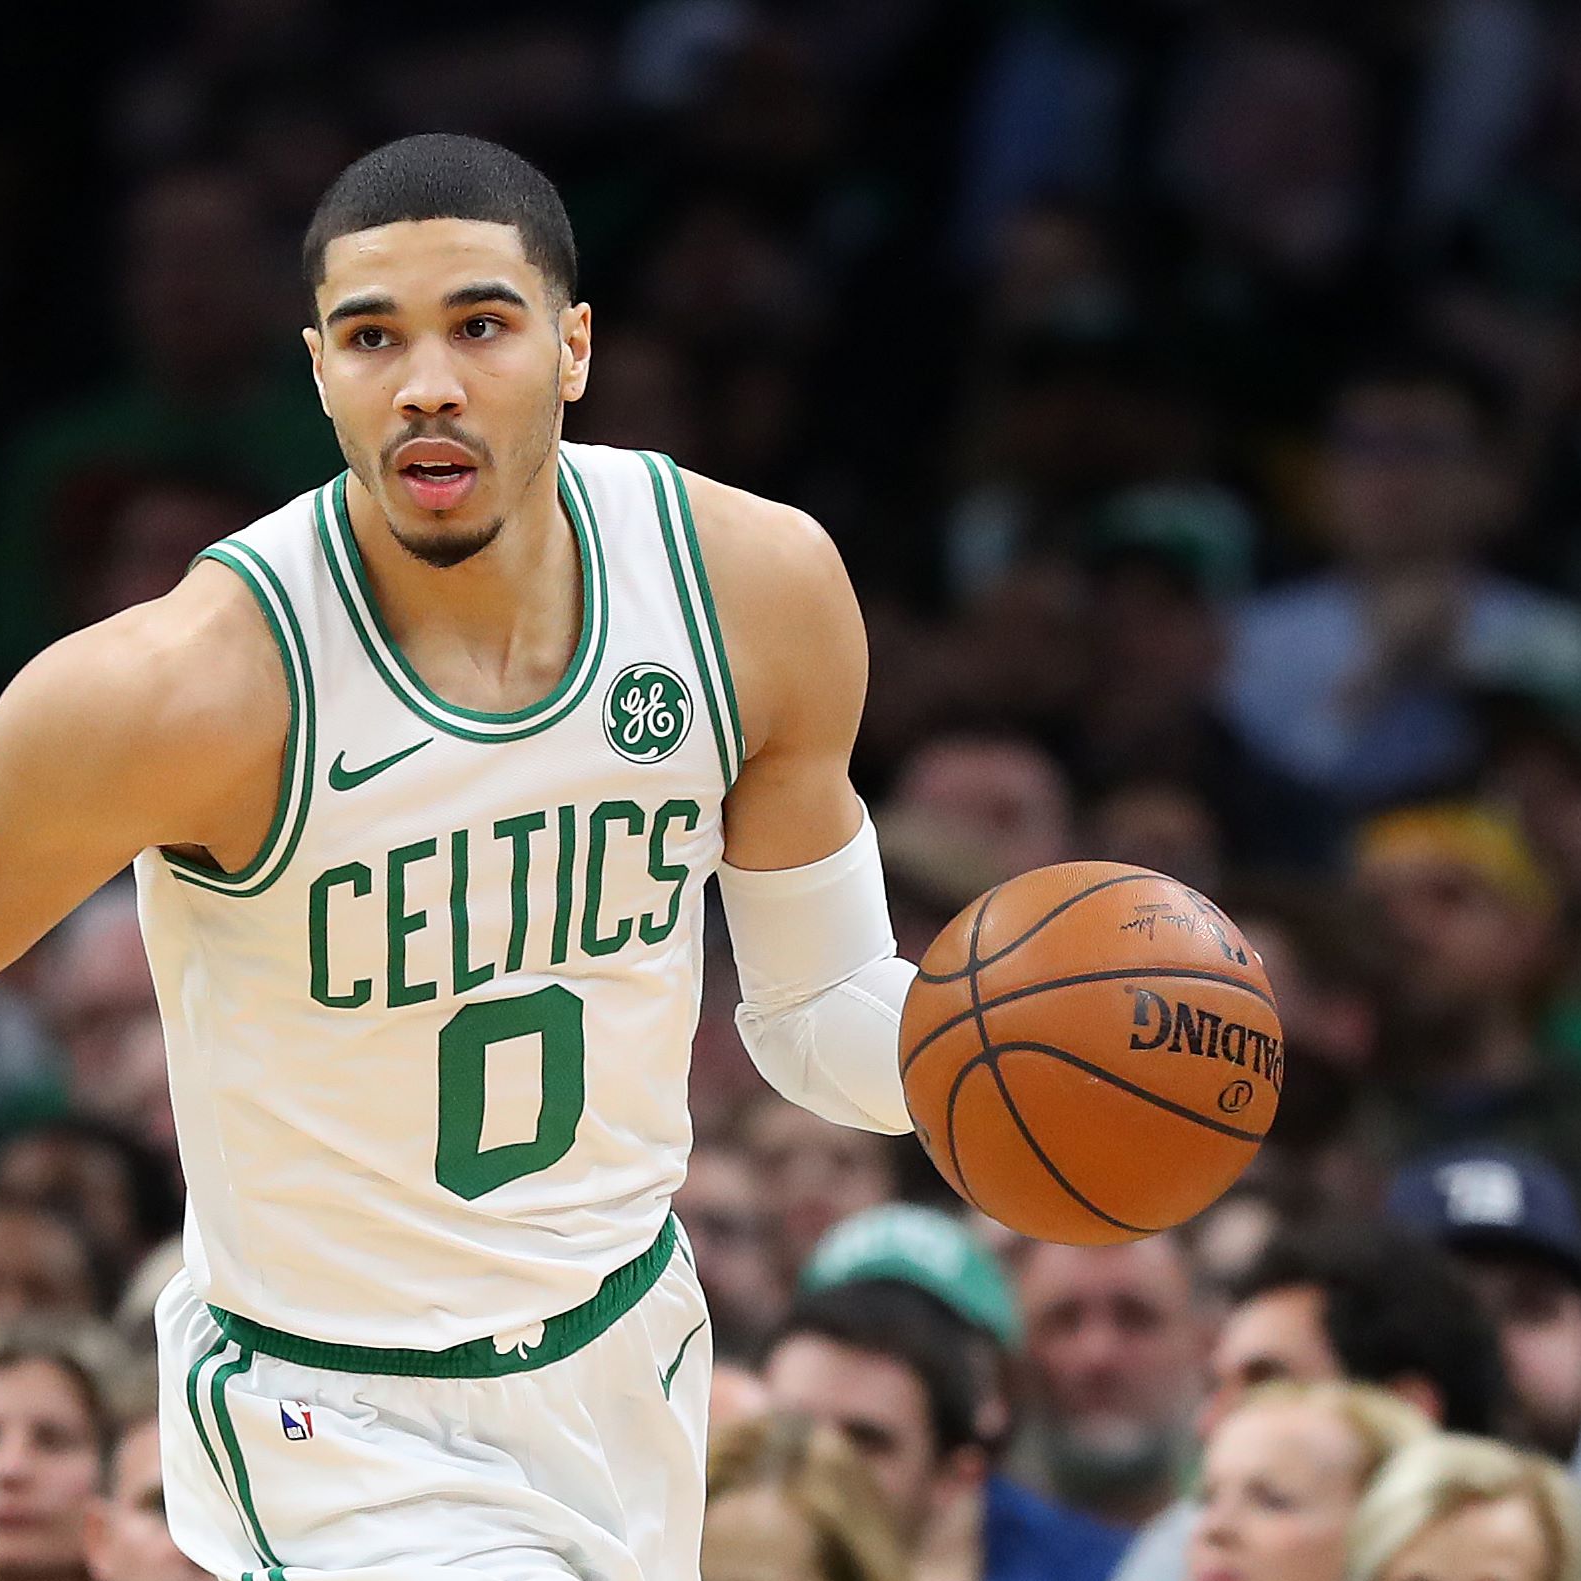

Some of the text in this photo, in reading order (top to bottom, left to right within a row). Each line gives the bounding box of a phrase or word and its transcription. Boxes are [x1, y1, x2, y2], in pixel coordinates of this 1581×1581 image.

[310, 798, 699, 1009] CELTICS
[434, 983, 585, 1201] 0
[1129, 988, 1284, 1094] PALDING
